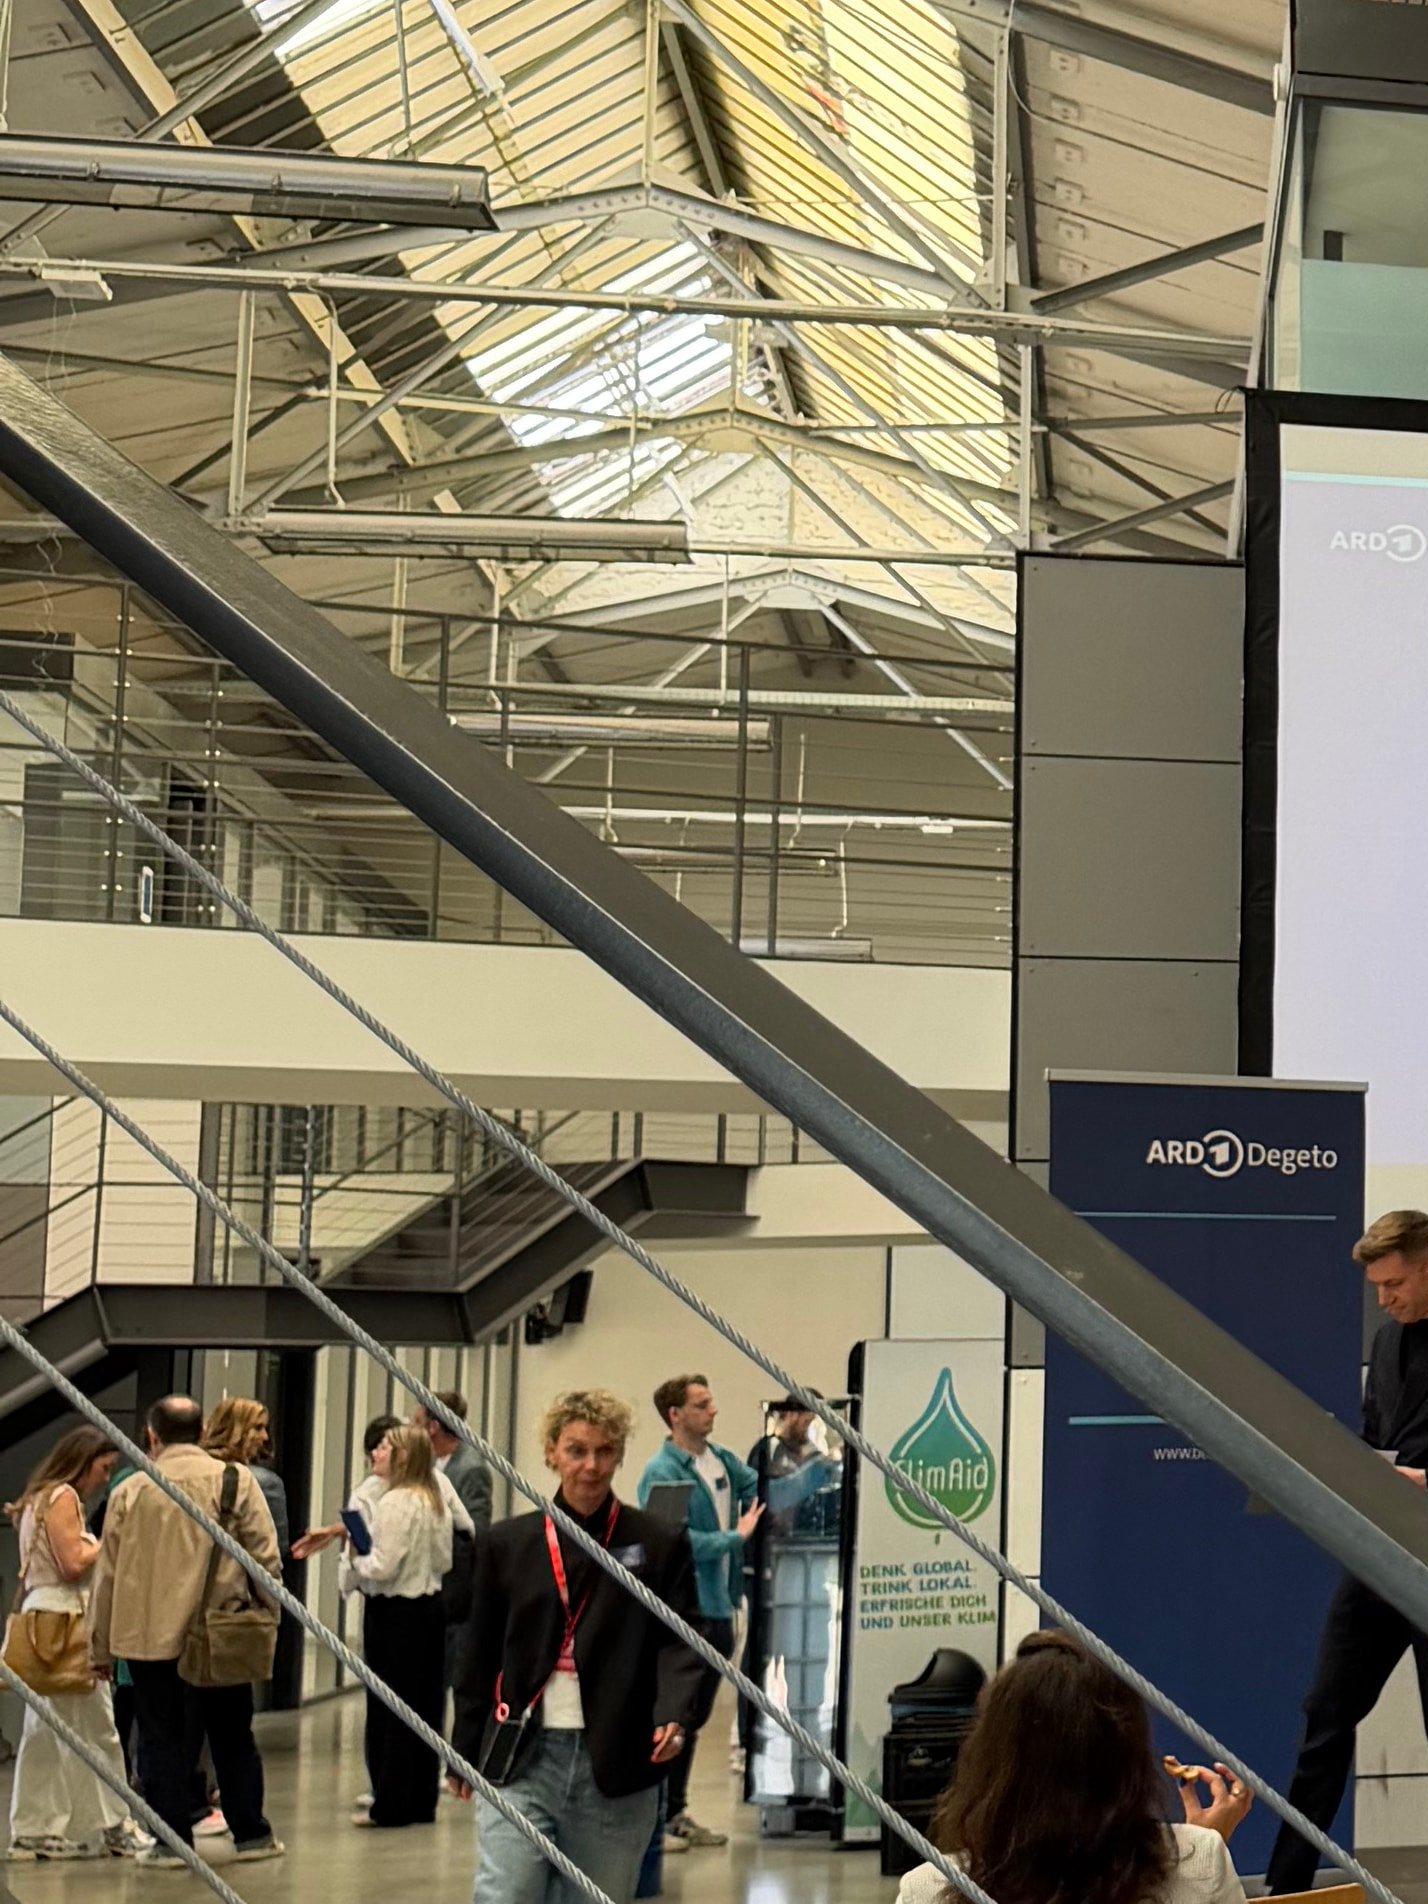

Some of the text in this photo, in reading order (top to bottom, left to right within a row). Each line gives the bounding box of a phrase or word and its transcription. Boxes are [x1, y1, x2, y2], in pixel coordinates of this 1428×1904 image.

[1330, 530, 1387, 551] ARD
[1145, 1139, 1205, 1164] ARD
[1248, 1143, 1338, 1175] Degeto
[859, 1564, 907, 1579] DENK
[860, 1579, 913, 1596] TRINK
[860, 1593, 987, 1614] ERFRISCHE DICH
[860, 1616, 894, 1630] UND
[899, 1611, 952, 1628] UNSER
